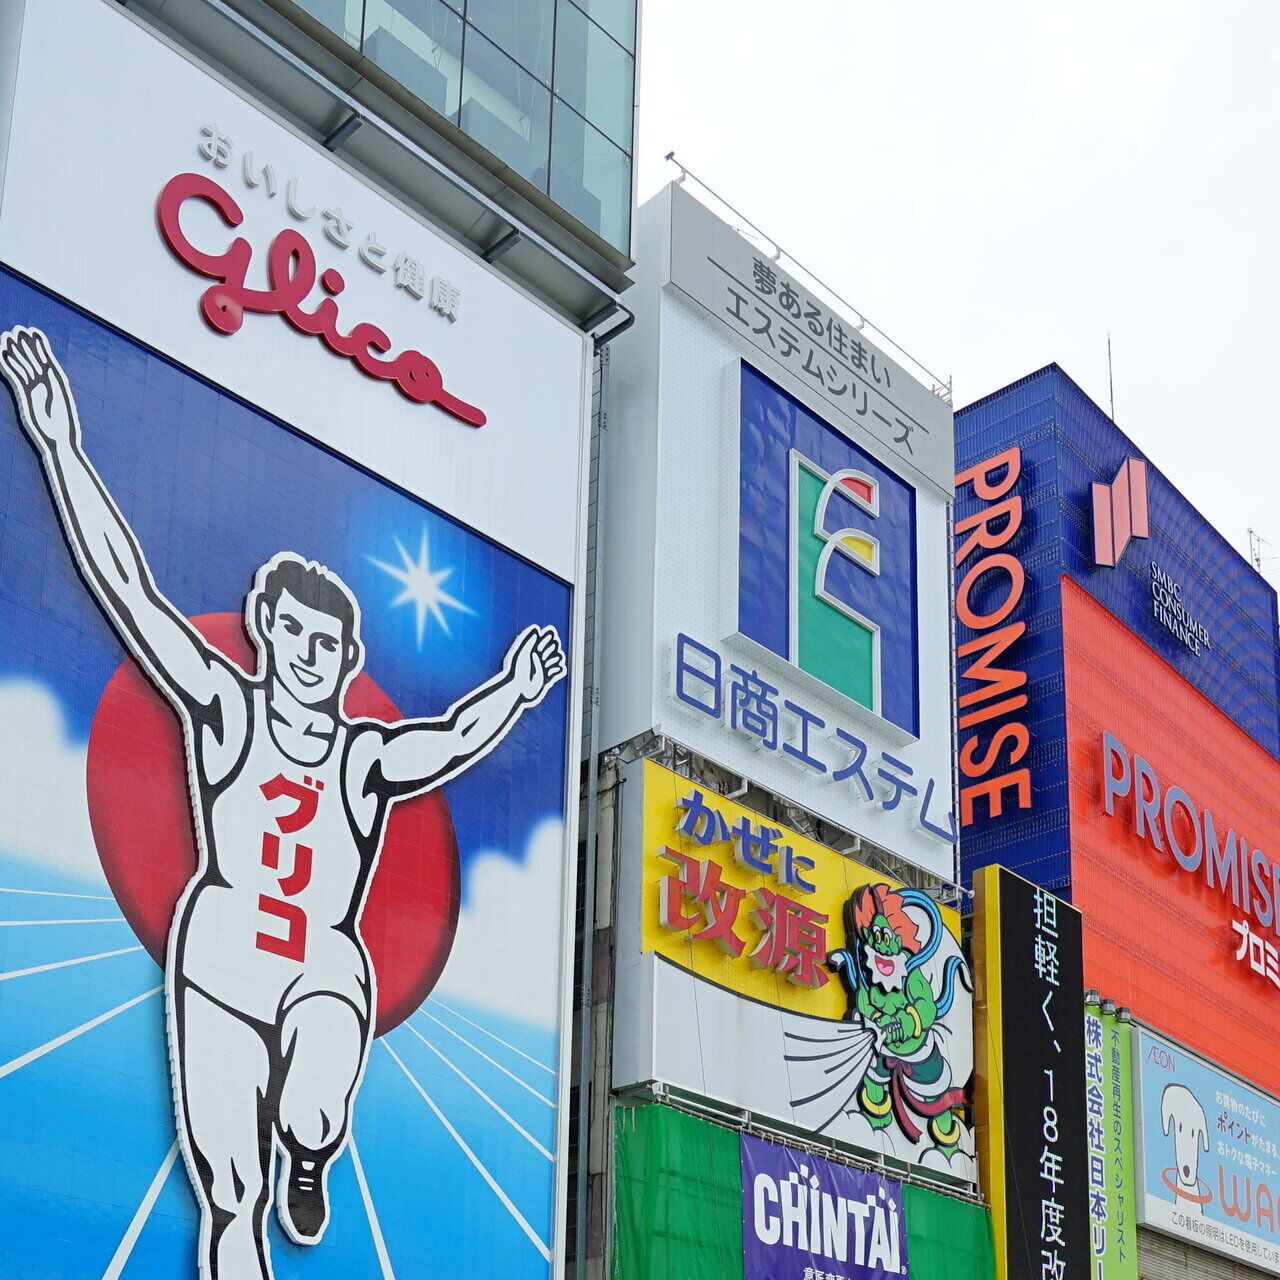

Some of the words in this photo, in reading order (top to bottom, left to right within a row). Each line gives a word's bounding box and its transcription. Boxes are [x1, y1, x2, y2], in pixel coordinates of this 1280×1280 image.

[157, 172, 488, 428] Glico
[200, 121, 462, 323] おいしさと健康
[724, 286, 915, 457] エステムシリーズ
[751, 255, 893, 389] 夢ある住まい
[954, 446, 1032, 828] PROMISE
[1150, 561, 1182, 602] SMBC
[1152, 580, 1212, 650] CONSUMER
[1153, 600, 1201, 657] FINANCE
[675, 631, 959, 845] 日商エステム
[255, 772, 325, 964] グリコ
[657, 846, 831, 990] 改源
[677, 789, 817, 896] かぜに
